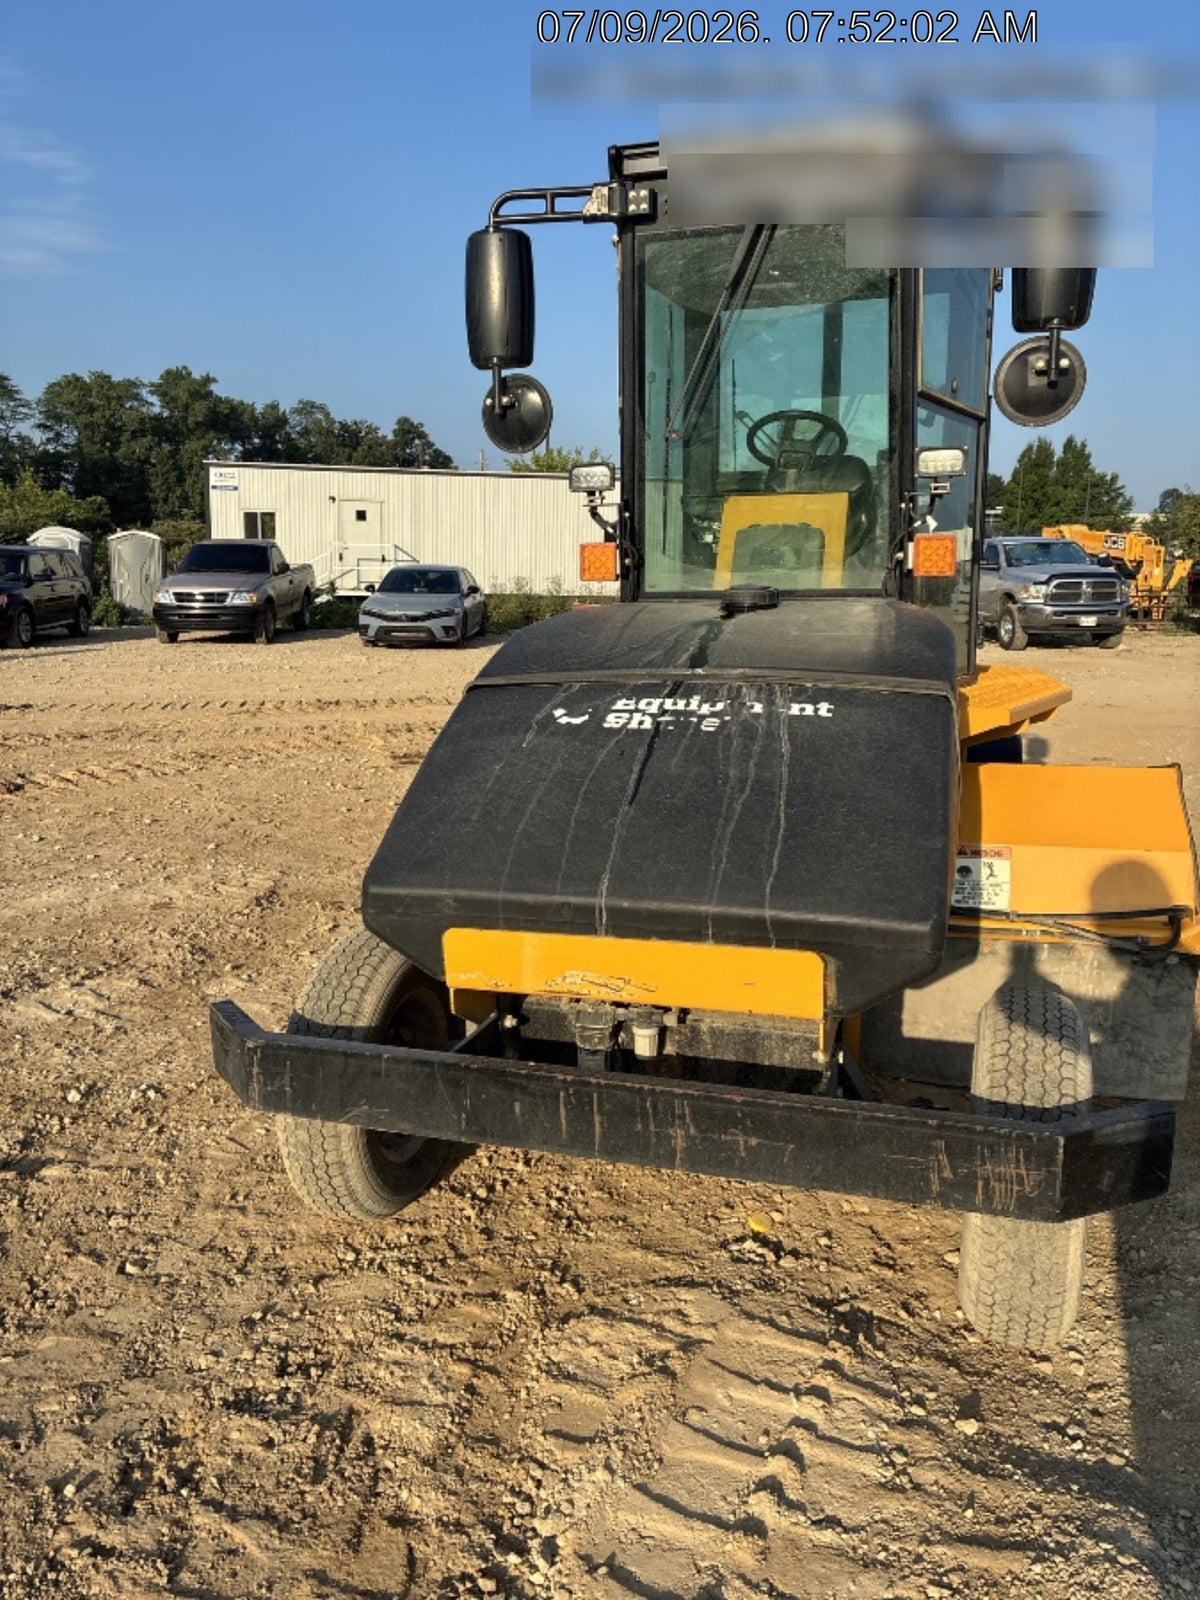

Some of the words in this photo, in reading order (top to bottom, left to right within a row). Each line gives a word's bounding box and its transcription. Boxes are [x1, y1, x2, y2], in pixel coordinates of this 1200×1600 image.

[1103, 536, 1125, 550] JCB
[611, 695, 834, 716] Equipnt
[602, 713, 721, 731] She
